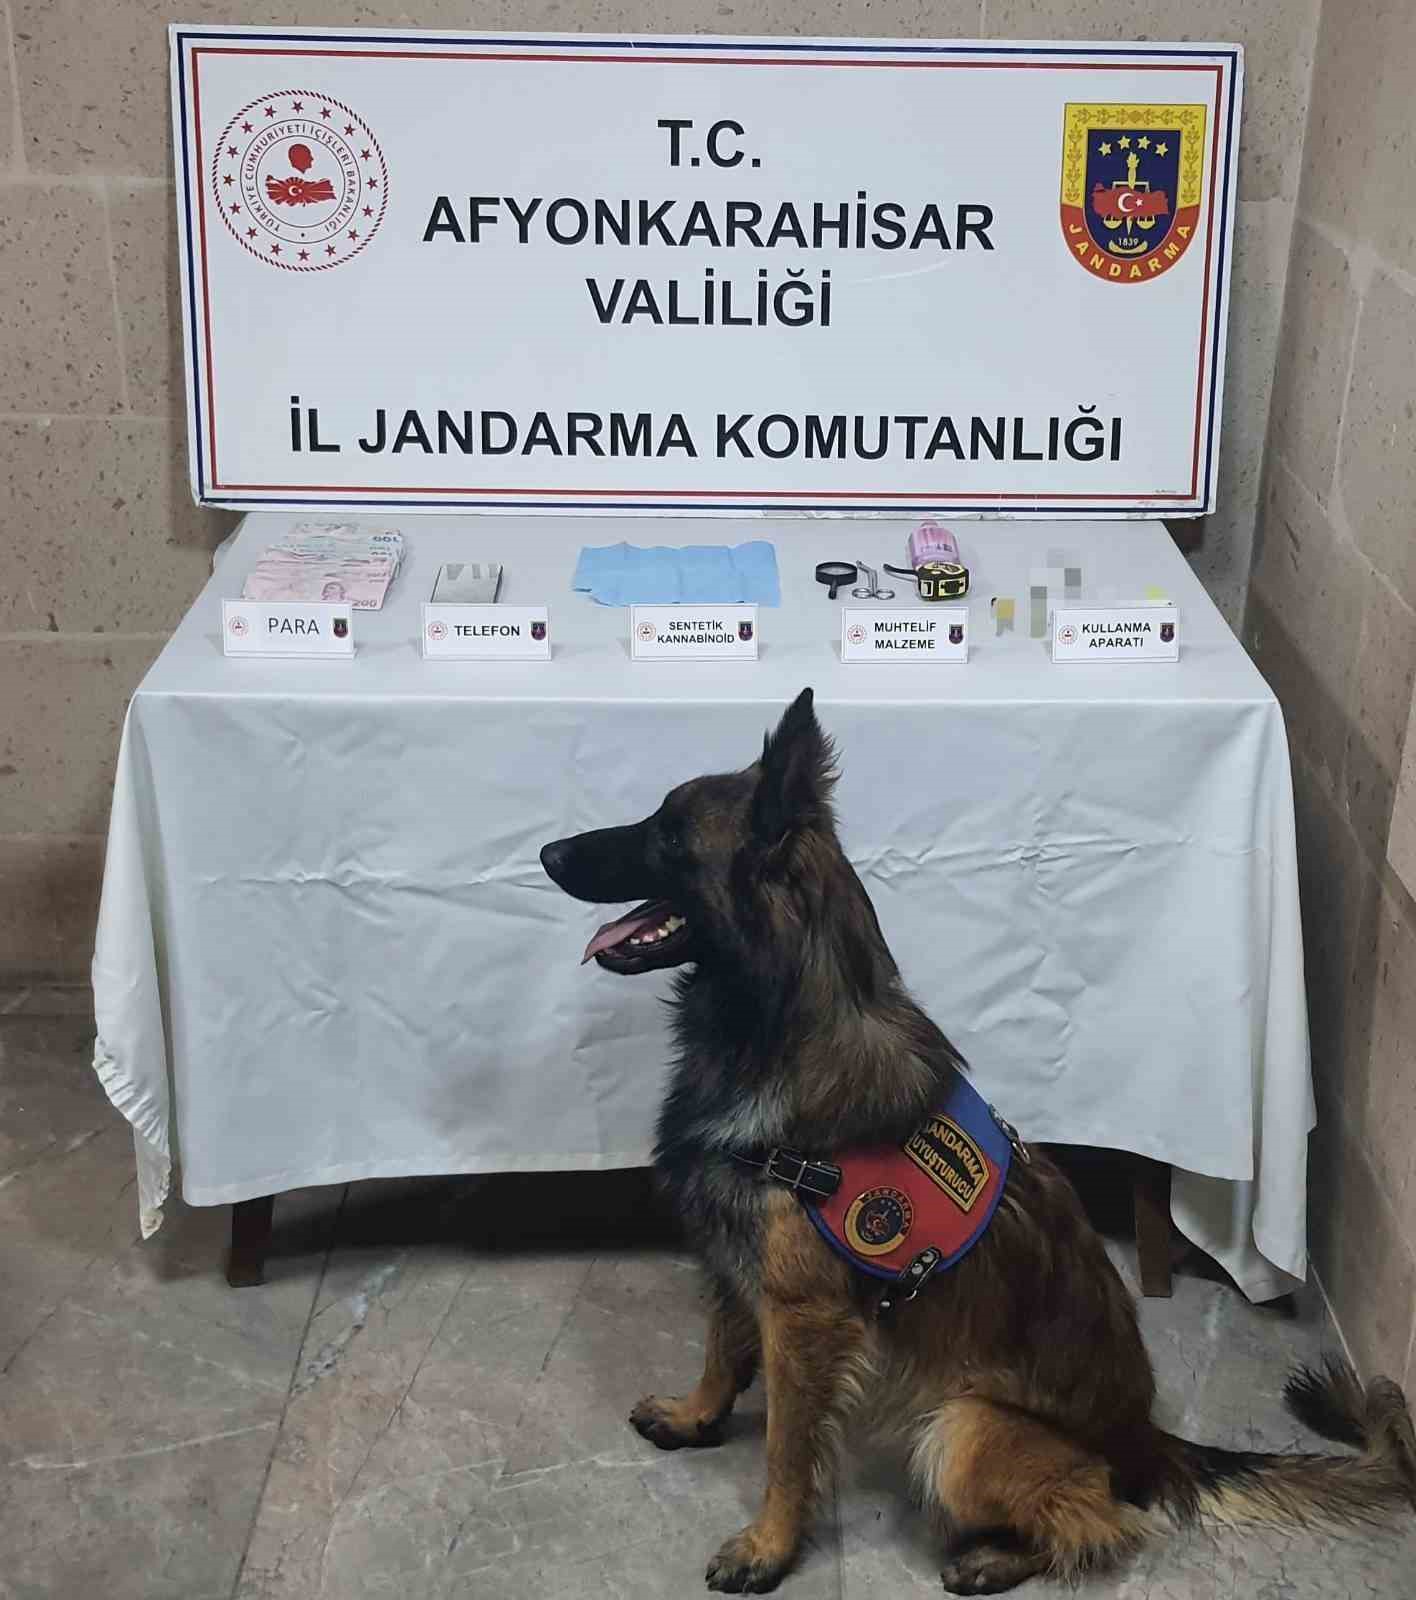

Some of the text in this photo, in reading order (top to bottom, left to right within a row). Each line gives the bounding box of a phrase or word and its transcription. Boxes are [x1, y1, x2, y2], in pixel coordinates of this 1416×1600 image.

[658, 119, 761, 168] T.C.
[246, 124, 356, 232] TÜRKİYE CUMHURİYETİ İÇİŞLERİ BAKANLIĞI
[423, 190, 995, 251] AFYONKARAHİSAR
[1117, 238, 1139, 247] 1839
[1069, 223, 1191, 278] JANDARMA
[586, 267, 831, 327] VALİLİĞİ
[290, 395, 1122, 462] İL JANDARMA KOMUTANLIĞI
[268, 617, 320, 635] PARA
[454, 625, 520, 637] TELEFON
[669, 619, 723, 631] SENTETİK
[874, 619, 937, 632] MUHTELİF
[1082, 622, 1152, 633] KULLANMA
[657, 632, 736, 644] KANNABİNOİD
[875, 639, 936, 649] MALZEME
[1089, 637, 1144, 648] APARATI
